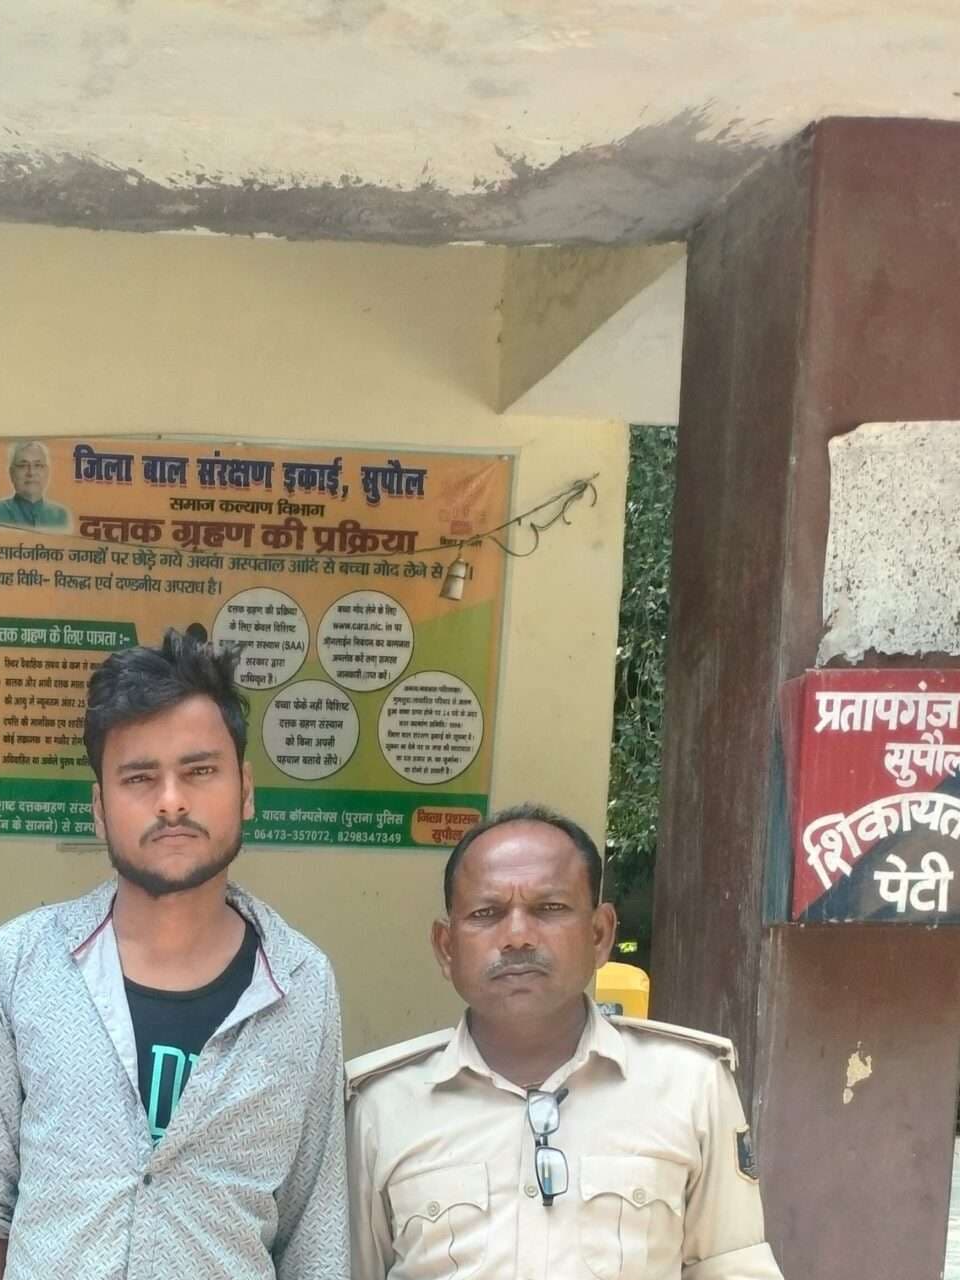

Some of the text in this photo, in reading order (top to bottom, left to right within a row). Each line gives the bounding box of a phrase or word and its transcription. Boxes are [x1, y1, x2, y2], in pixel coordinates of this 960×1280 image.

[73, 444, 135, 485] जिला
[142, 456, 189, 488] बाल
[197, 450, 275, 490] संरक्षण
[361, 459, 427, 506] सुपौल
[169, 497, 326, 517] समाज कल्याण विभाग
[79, 515, 165, 544] दत्तक
[261, 516, 308, 551] की
[312, 519, 419, 554] प्रक्रिया
[111, 551, 130, 565] पर
[159, 552, 183, 568] गये
[228, 557, 286, 573] अस्पताल
[288, 557, 320, 573] आदि
[323, 558, 336, 574] से
[339, 561, 370, 576] बच्चा
[373, 560, 400, 577] गोद
[403, 561, 428, 579] लेने
[431, 562, 444, 580] से
[94, 573, 114, 590] एवं
[115, 575, 161, 593] दण्डनीय
[164, 579, 205, 595] अपराध
[20, 627, 47, 644] ग्रहण
[49, 625, 60, 644] के
[63, 624, 84, 646] लिए
[86, 630, 117, 647] पात्रता
[814, 681, 960, 733] प्रतापगंज
[12, 815, 22, 830] के
[62, 817, 71, 833] से
[262, 809, 286, 822] यादव
[376, 808, 404, 829] पुलिस
[874, 851, 954, 913] पेटी
